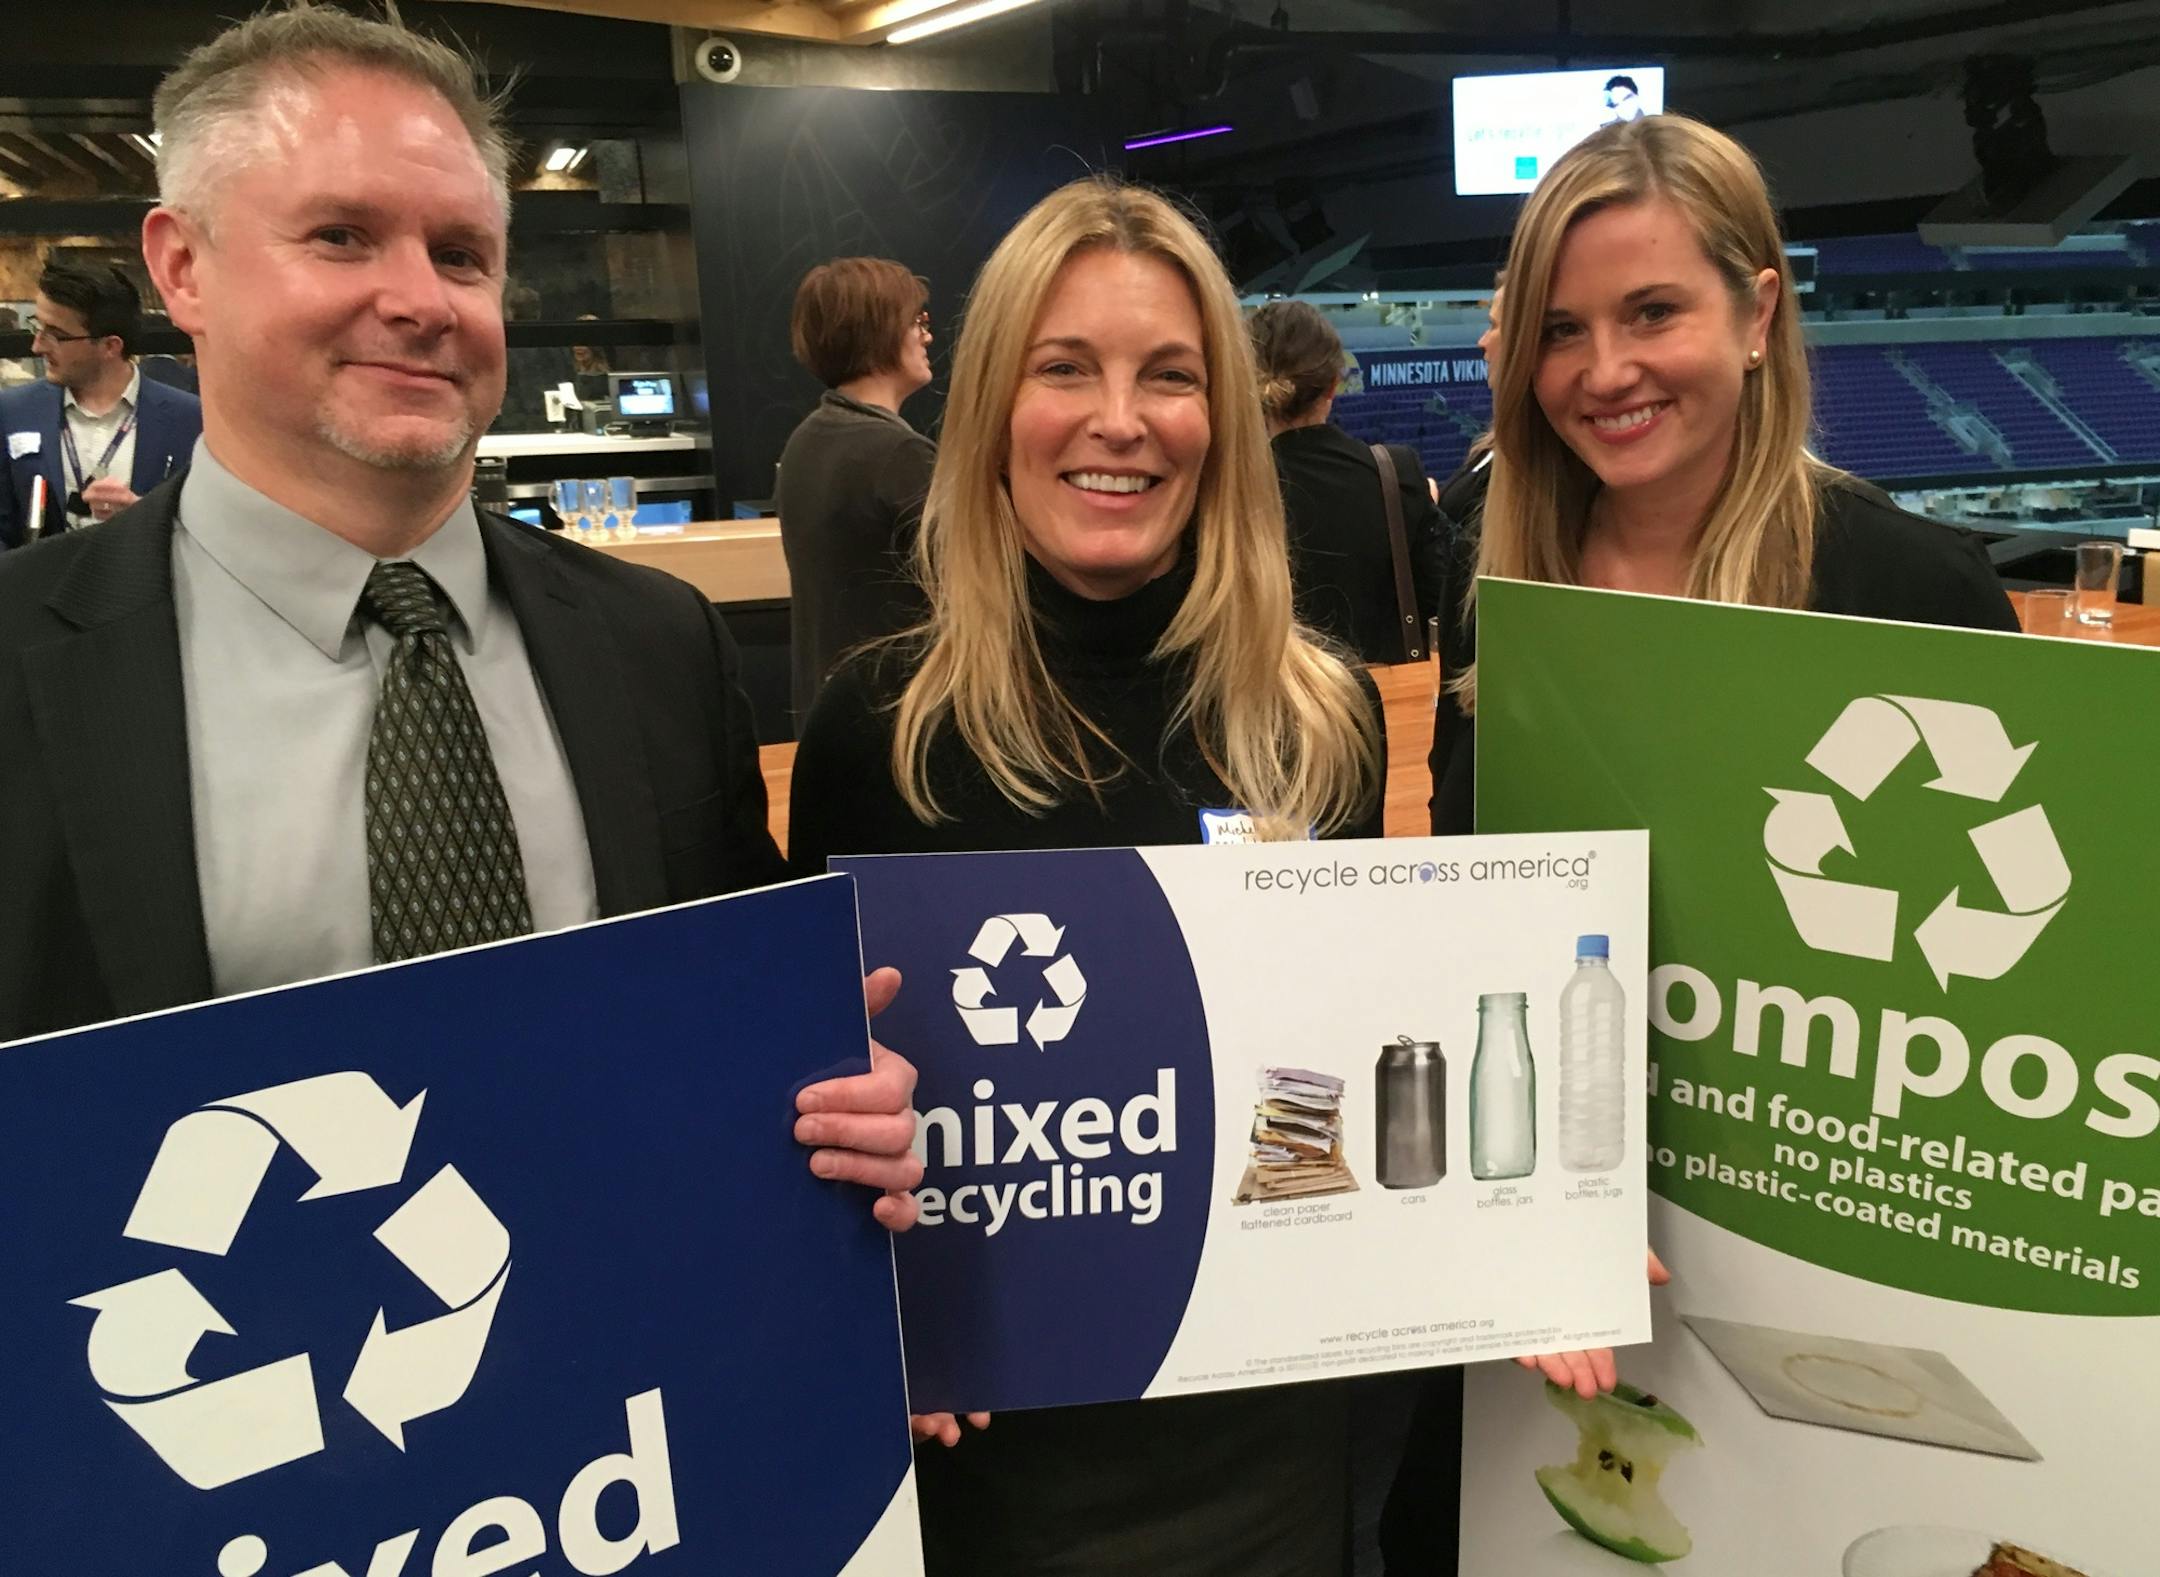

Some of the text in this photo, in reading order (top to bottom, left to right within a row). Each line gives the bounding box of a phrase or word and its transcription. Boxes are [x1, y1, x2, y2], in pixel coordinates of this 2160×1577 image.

[1370, 360, 1450, 386] MINNESOTA
[1245, 860, 1359, 894] recycle
[1368, 860, 1460, 887] across
[1670, 1074, 1756, 1122] and
[1768, 1094, 2088, 1201] food-related
[1774, 1142, 1975, 1211] no plastics
[1401, 1194, 1427, 1205] cans
[1493, 1185, 1517, 1198] glass
[1241, 1211, 1353, 1231] flattened cardboard
[1263, 1202, 1331, 1218] clean paper
[1685, 1152, 1941, 1241] plastic-coated
[1951, 1222, 2141, 1290] materials
[1345, 1327, 1388, 1344] recycle
[1391, 1324, 1427, 1337] across
[1429, 1318, 1476, 1333] america
